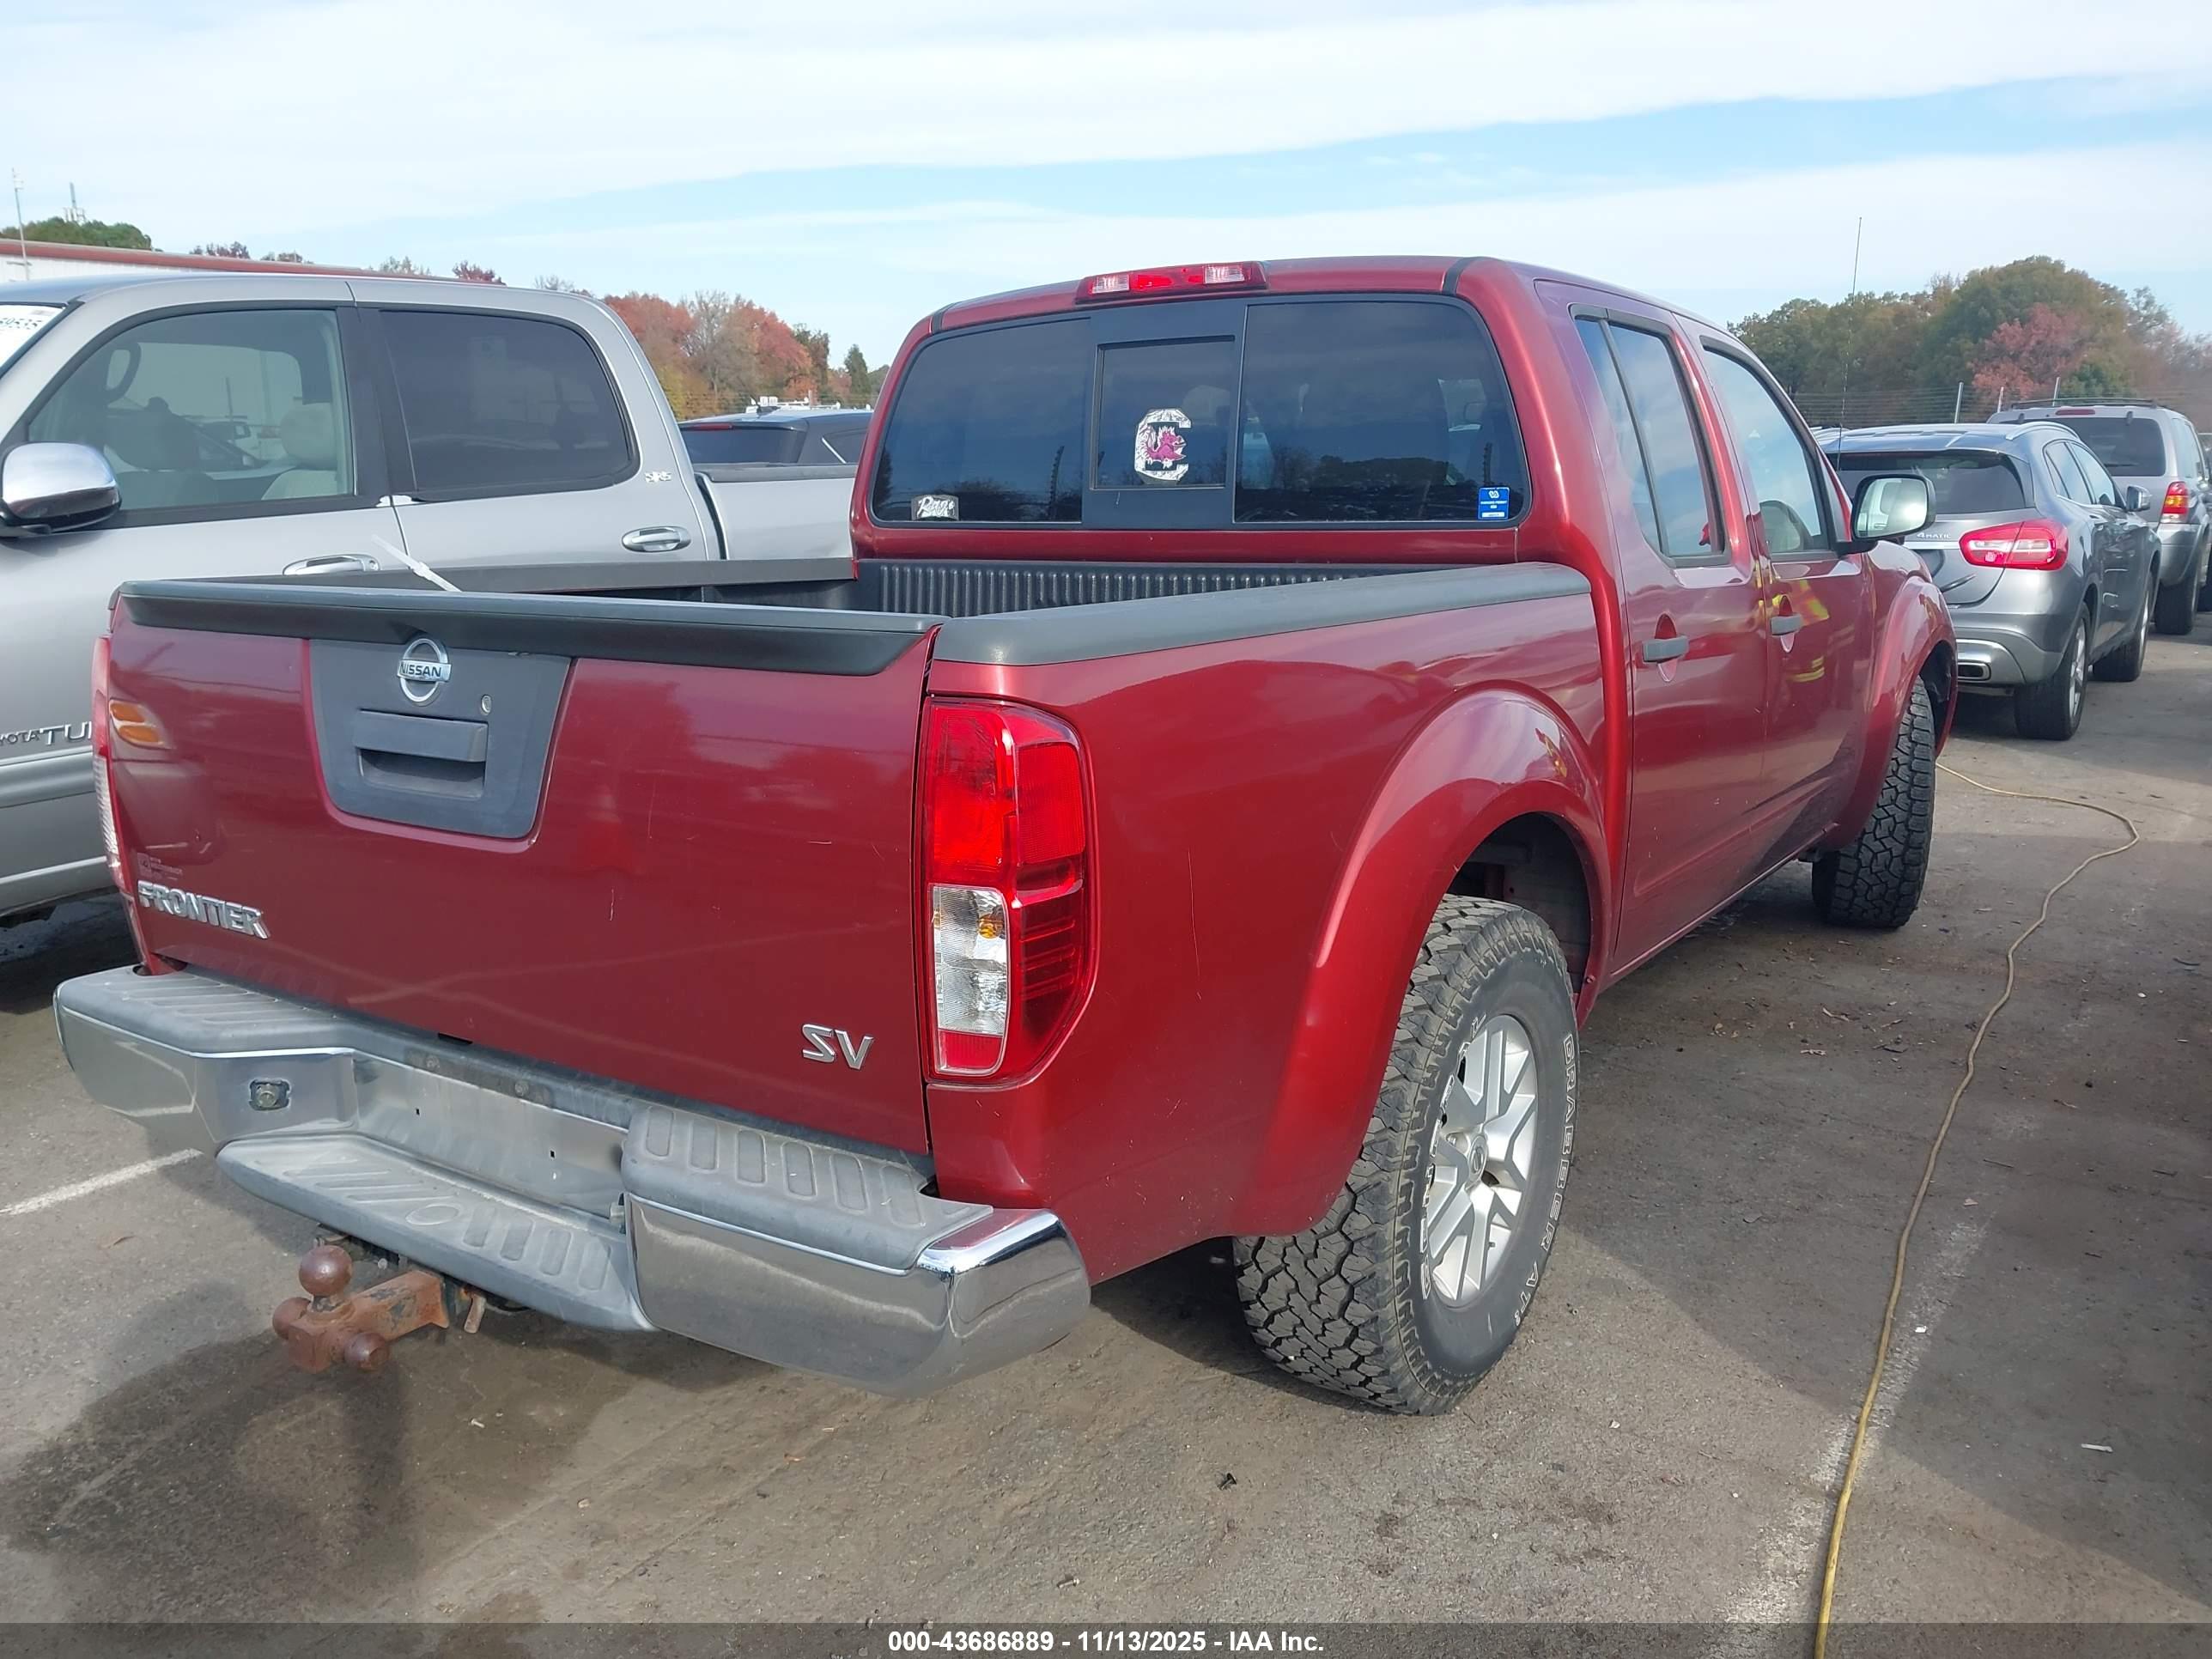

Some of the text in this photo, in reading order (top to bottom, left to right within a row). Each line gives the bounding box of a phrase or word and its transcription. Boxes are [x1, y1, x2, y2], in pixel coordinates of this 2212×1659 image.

[398, 660, 442, 678] NISSAN
[137, 879, 270, 939] FRONTIER
[801, 1023, 875, 1071] SV
[1540, 1032, 1577, 1252] GRABBER
